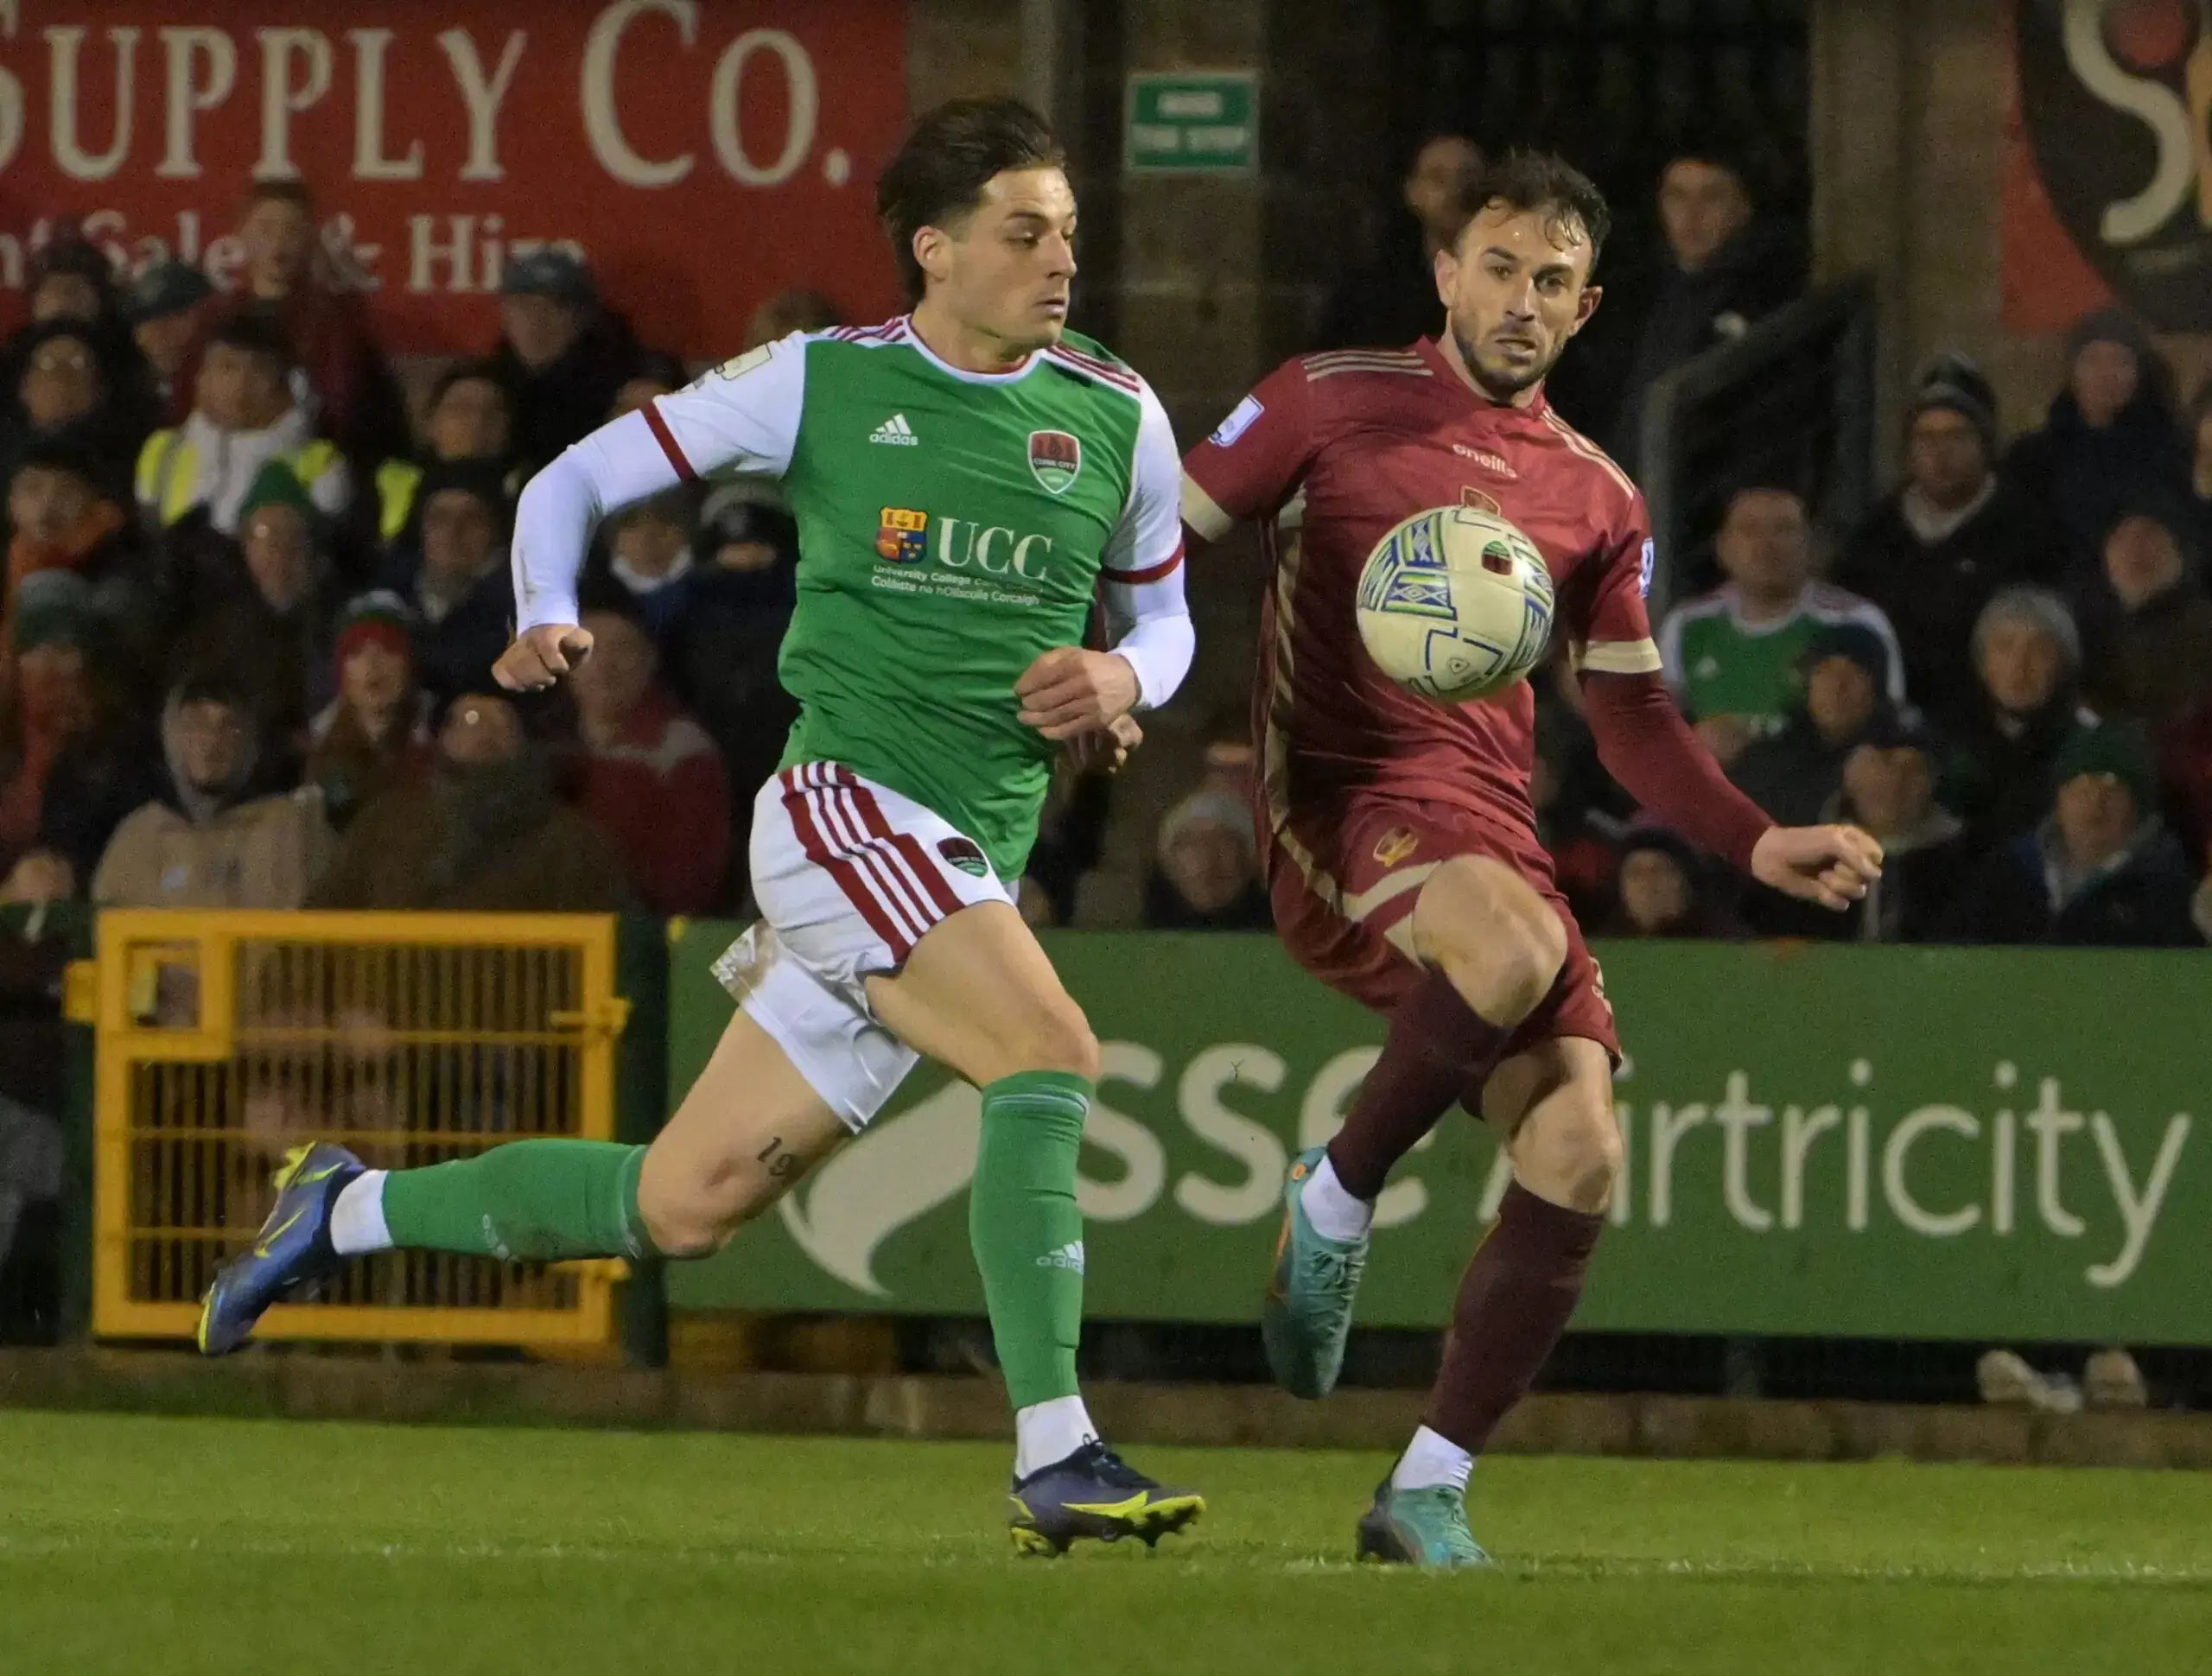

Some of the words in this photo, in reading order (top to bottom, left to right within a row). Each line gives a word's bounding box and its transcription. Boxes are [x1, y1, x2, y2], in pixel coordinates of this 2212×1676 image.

[868, 431, 918, 446] adidas
[938, 517, 1052, 581] UCC
[1477, 1056, 2192, 1289] irtricity
